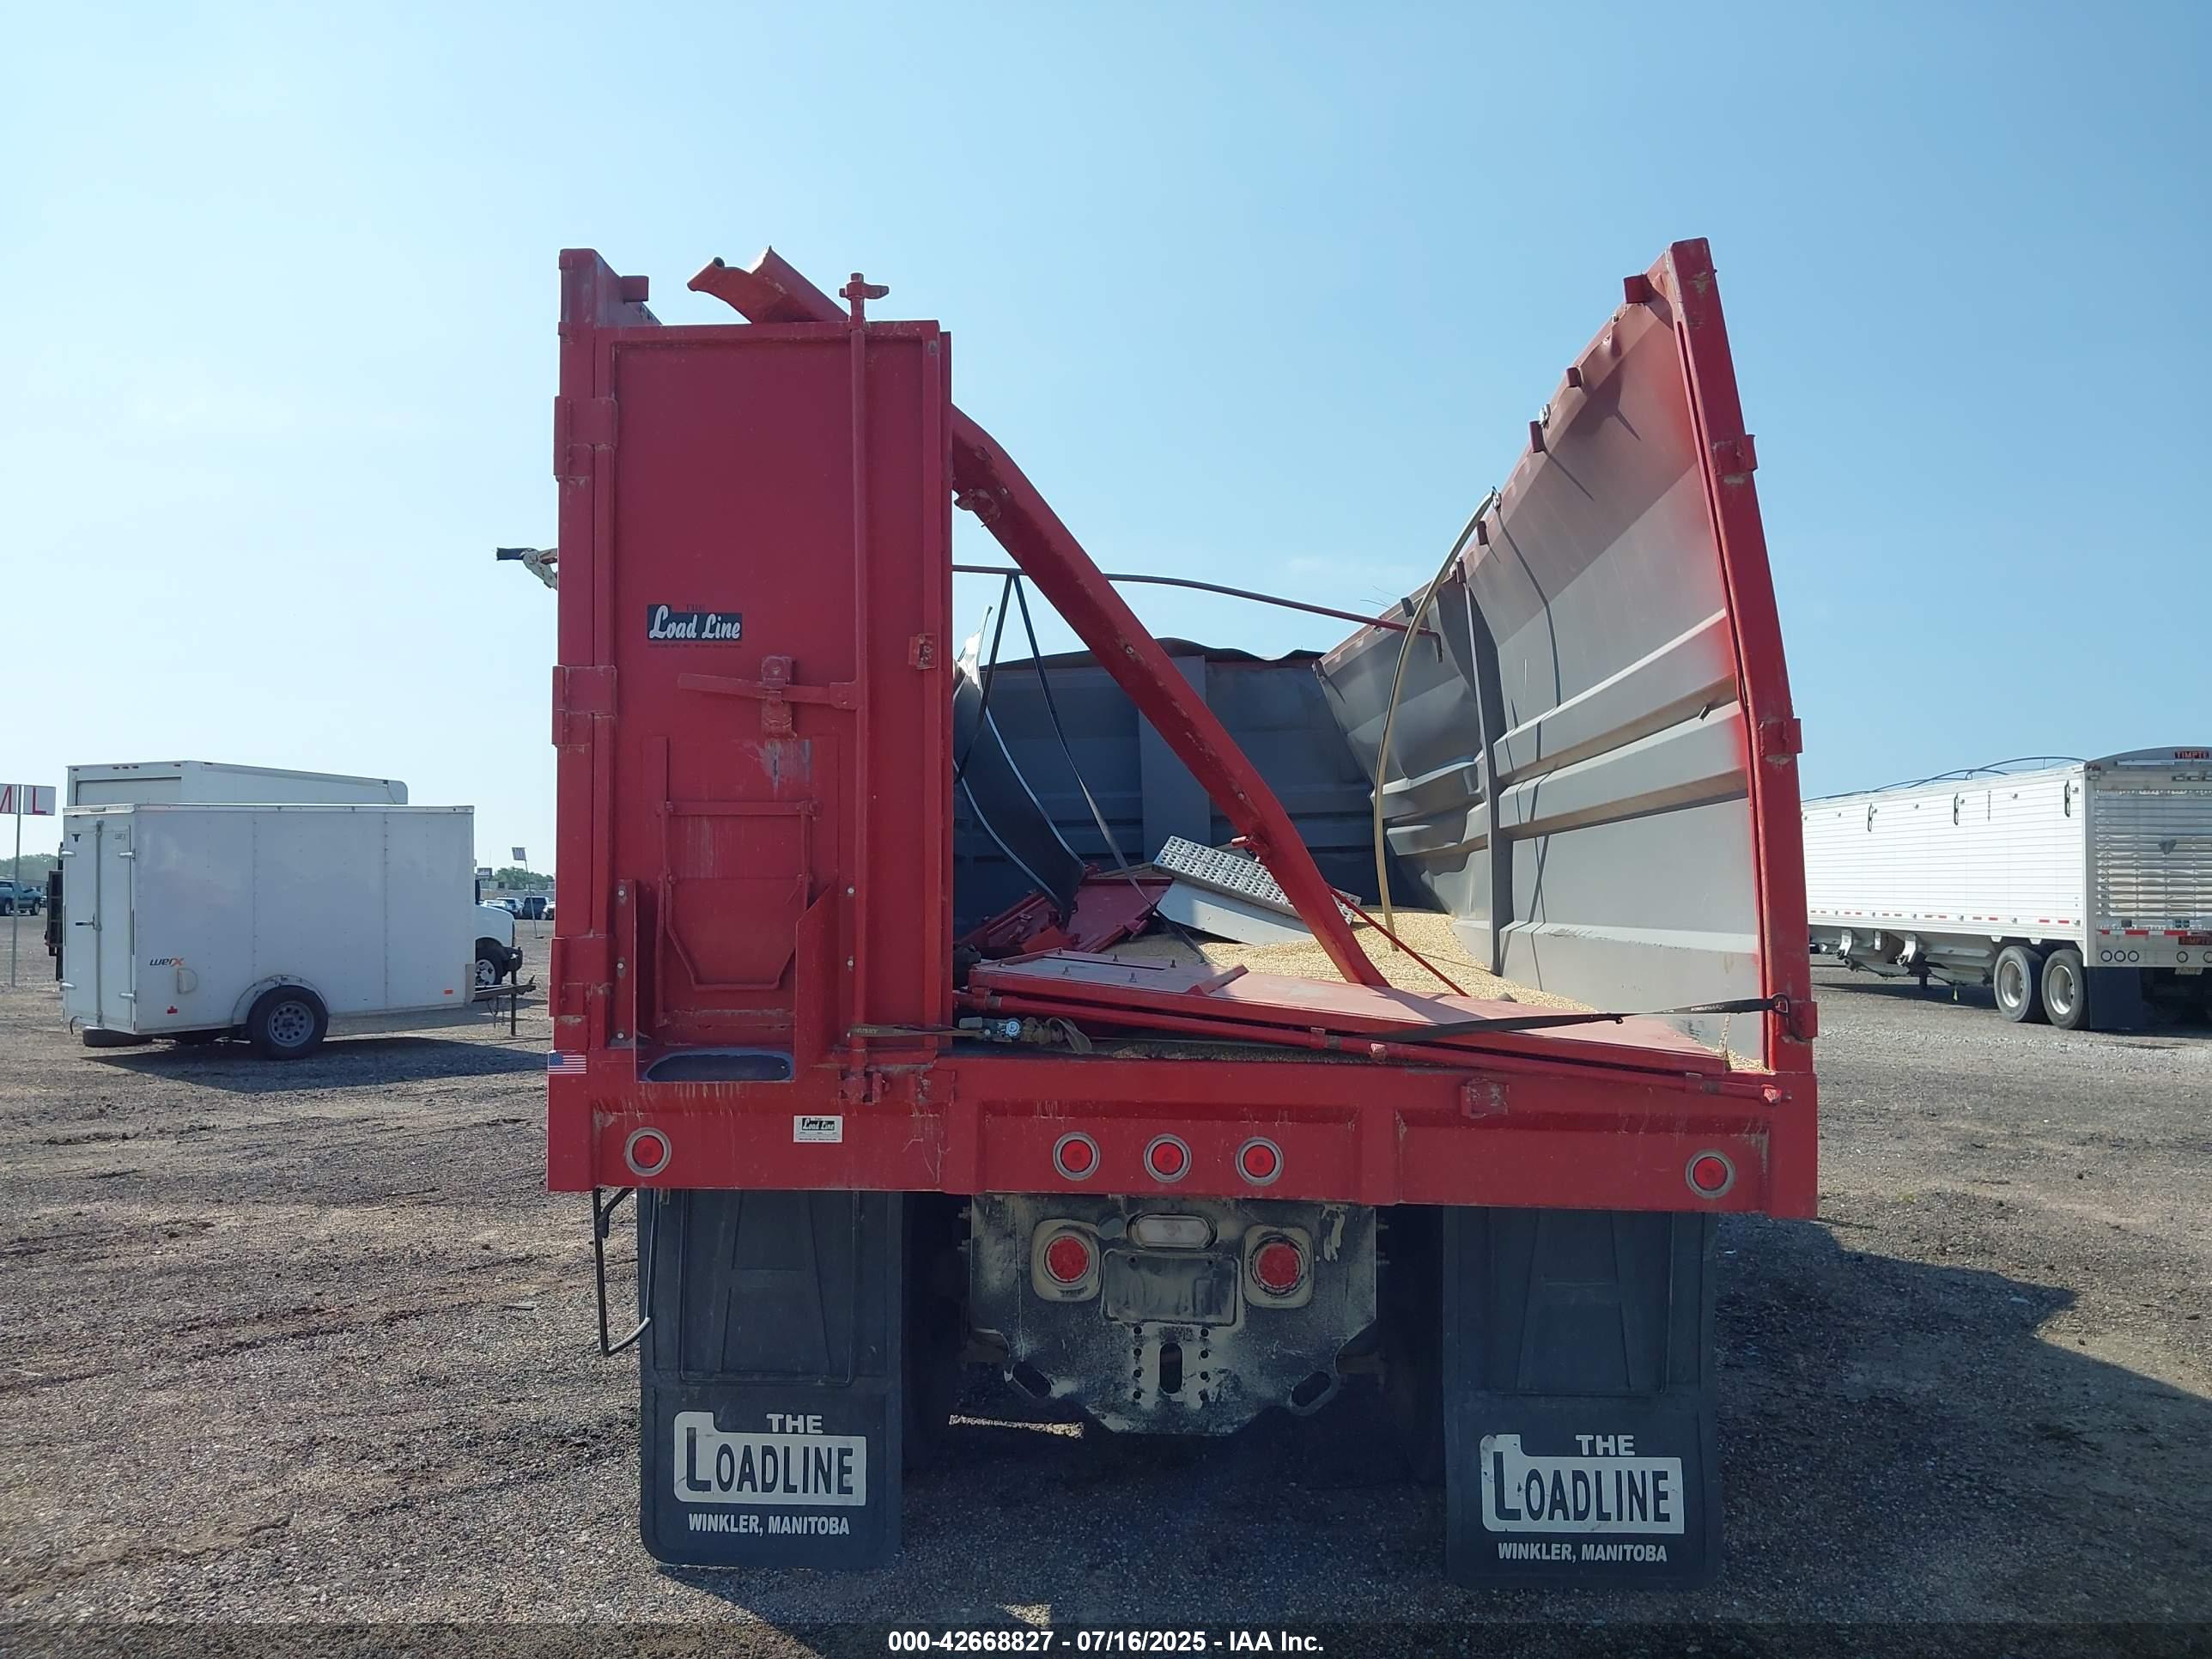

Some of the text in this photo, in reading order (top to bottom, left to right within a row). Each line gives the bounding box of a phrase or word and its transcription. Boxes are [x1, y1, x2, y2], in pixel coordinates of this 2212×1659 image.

[648, 605, 741, 640] Load Line
[2176, 750, 2209, 759] TIMPTE
[32, 787, 47, 815] L
[802, 1118, 820, 1130] Load
[821, 1121, 835, 1130] Line
[766, 1413, 823, 1435] THE
[1575, 1434, 1636, 1456] THE
[686, 1426, 854, 1495] LOADLINE
[1492, 1450, 1671, 1522] LOADLINE
[688, 1513, 850, 1536] WINKLER, MANITOBA
[1498, 1542, 1668, 1563] WINKLER, MANITOBA
